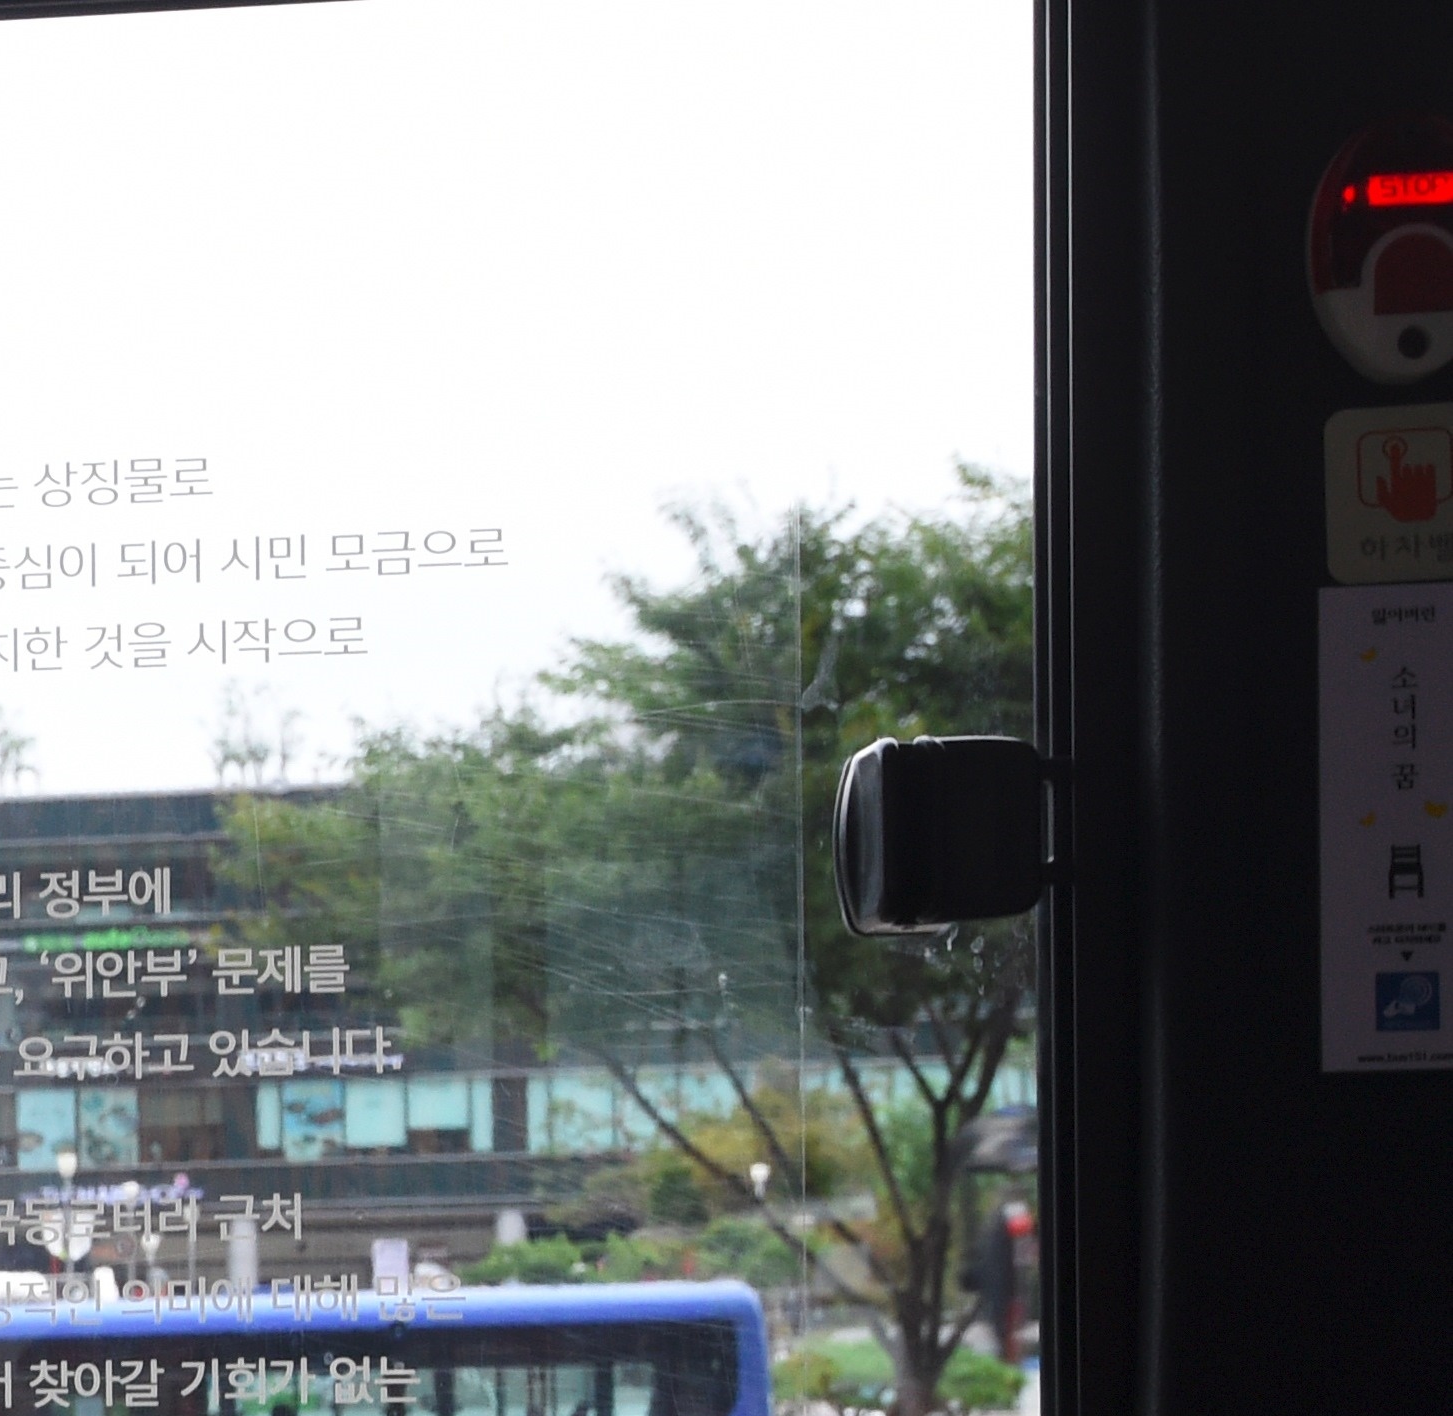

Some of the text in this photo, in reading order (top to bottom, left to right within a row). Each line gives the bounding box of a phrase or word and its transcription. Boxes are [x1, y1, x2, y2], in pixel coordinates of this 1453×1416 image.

[33, 457, 213, 507] 상징물로
[117, 537, 202, 585] 되어
[220, 534, 307, 580] 시민
[325, 528, 509, 576] 모금으로
[83, 621, 172, 671] 것을
[186, 616, 369, 664] 시작으로
[38, 866, 172, 918] 정부에
[212, 943, 350, 995] 문제를
[14, 1029, 196, 1080] 요구하고
[213, 1192, 304, 1241] 근처
[121, 1275, 254, 1324] 의미에
[270, 1272, 359, 1322] 대해
[375, 1272, 467, 1322] 많은
[29, 1357, 165, 1409] 찾아갈
[179, 1356, 316, 1407] 기회가
[329, 1355, 421, 1405] 없는
